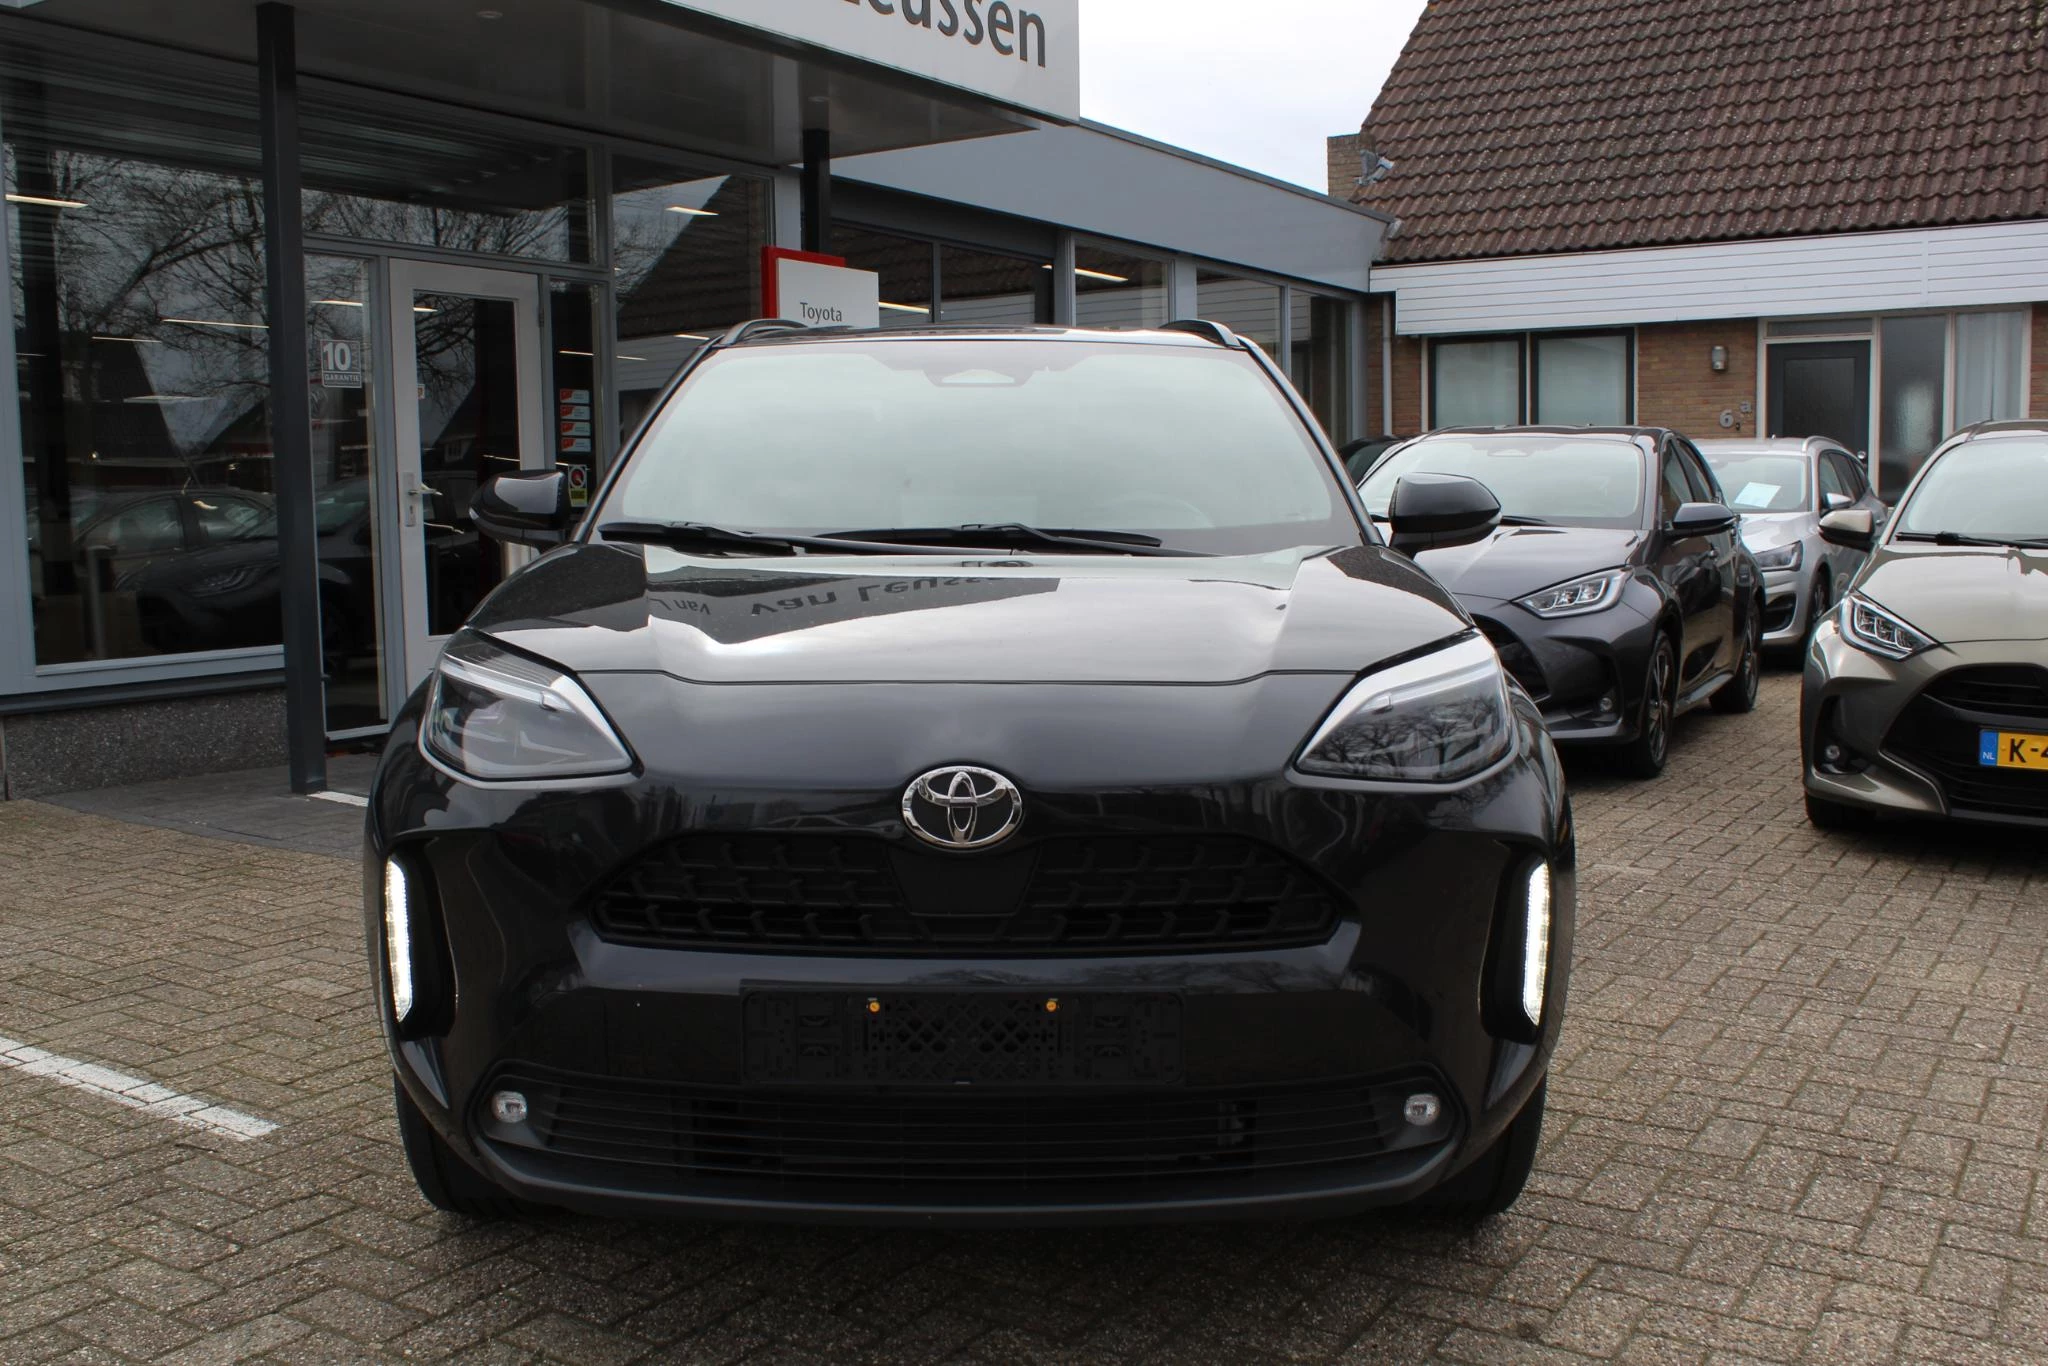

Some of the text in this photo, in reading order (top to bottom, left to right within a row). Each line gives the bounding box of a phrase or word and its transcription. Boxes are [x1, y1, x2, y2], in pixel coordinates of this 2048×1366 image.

[843, 0, 1046, 68] ussen
[800, 301, 842, 324] Toyota
[323, 341, 351, 371] 10
[1982, 751, 1995, 760] NL
